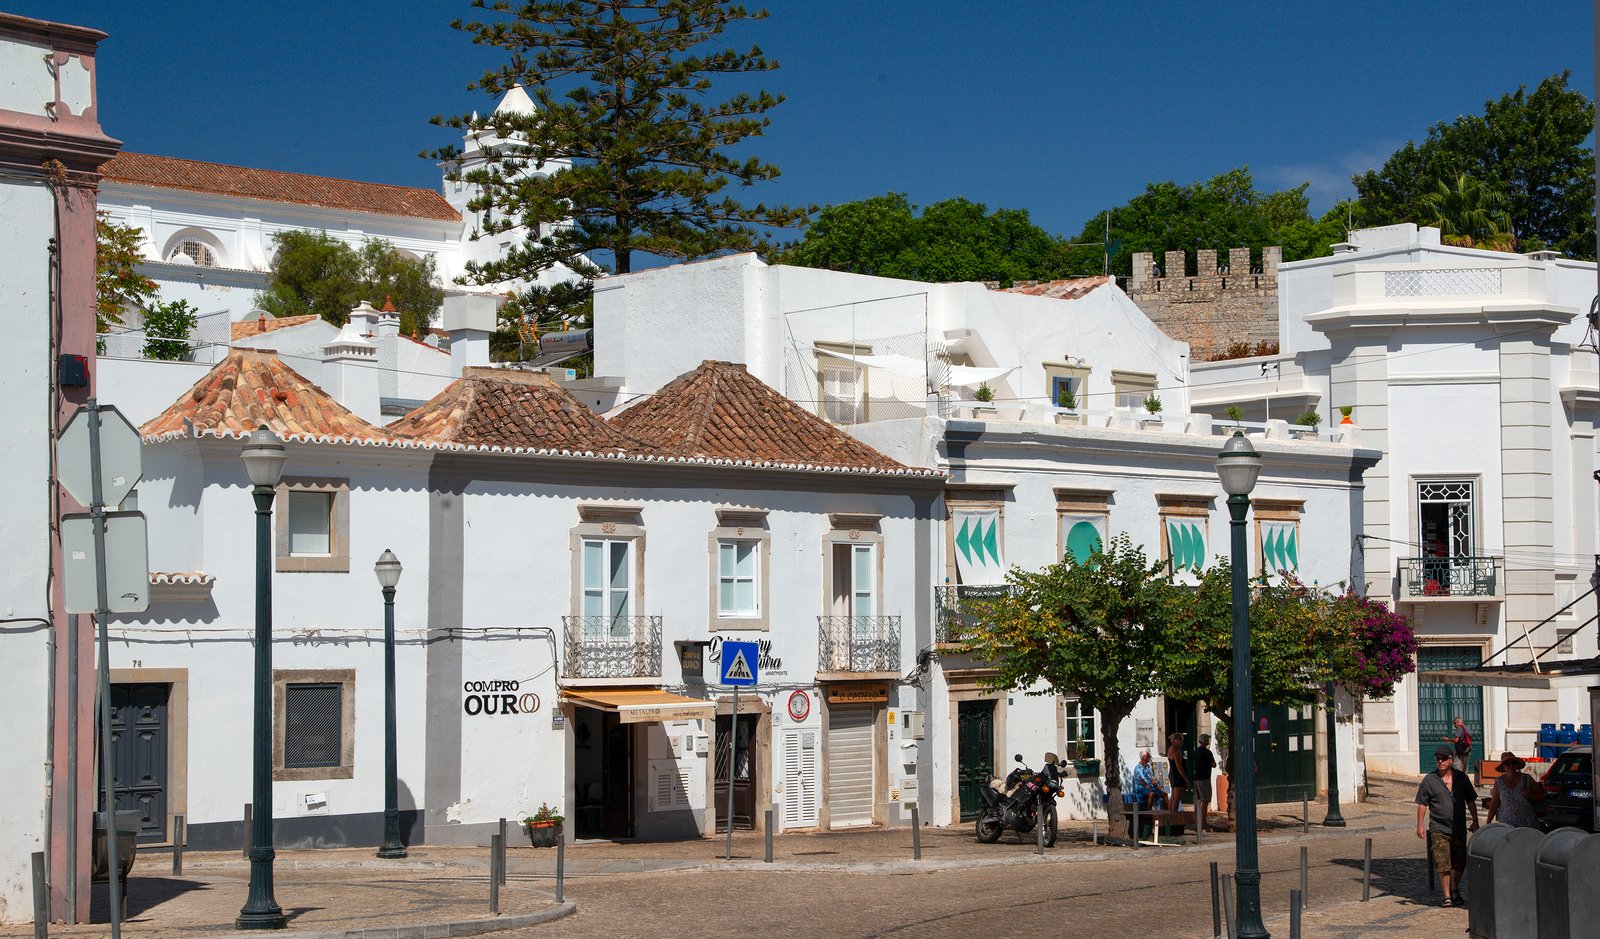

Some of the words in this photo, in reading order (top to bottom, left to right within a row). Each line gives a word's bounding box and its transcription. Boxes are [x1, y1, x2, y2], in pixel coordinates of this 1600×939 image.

[464, 680, 519, 692] COMPRO
[847, 691, 878, 701] CASTELO
[630, 708, 660, 716] METALPRO
